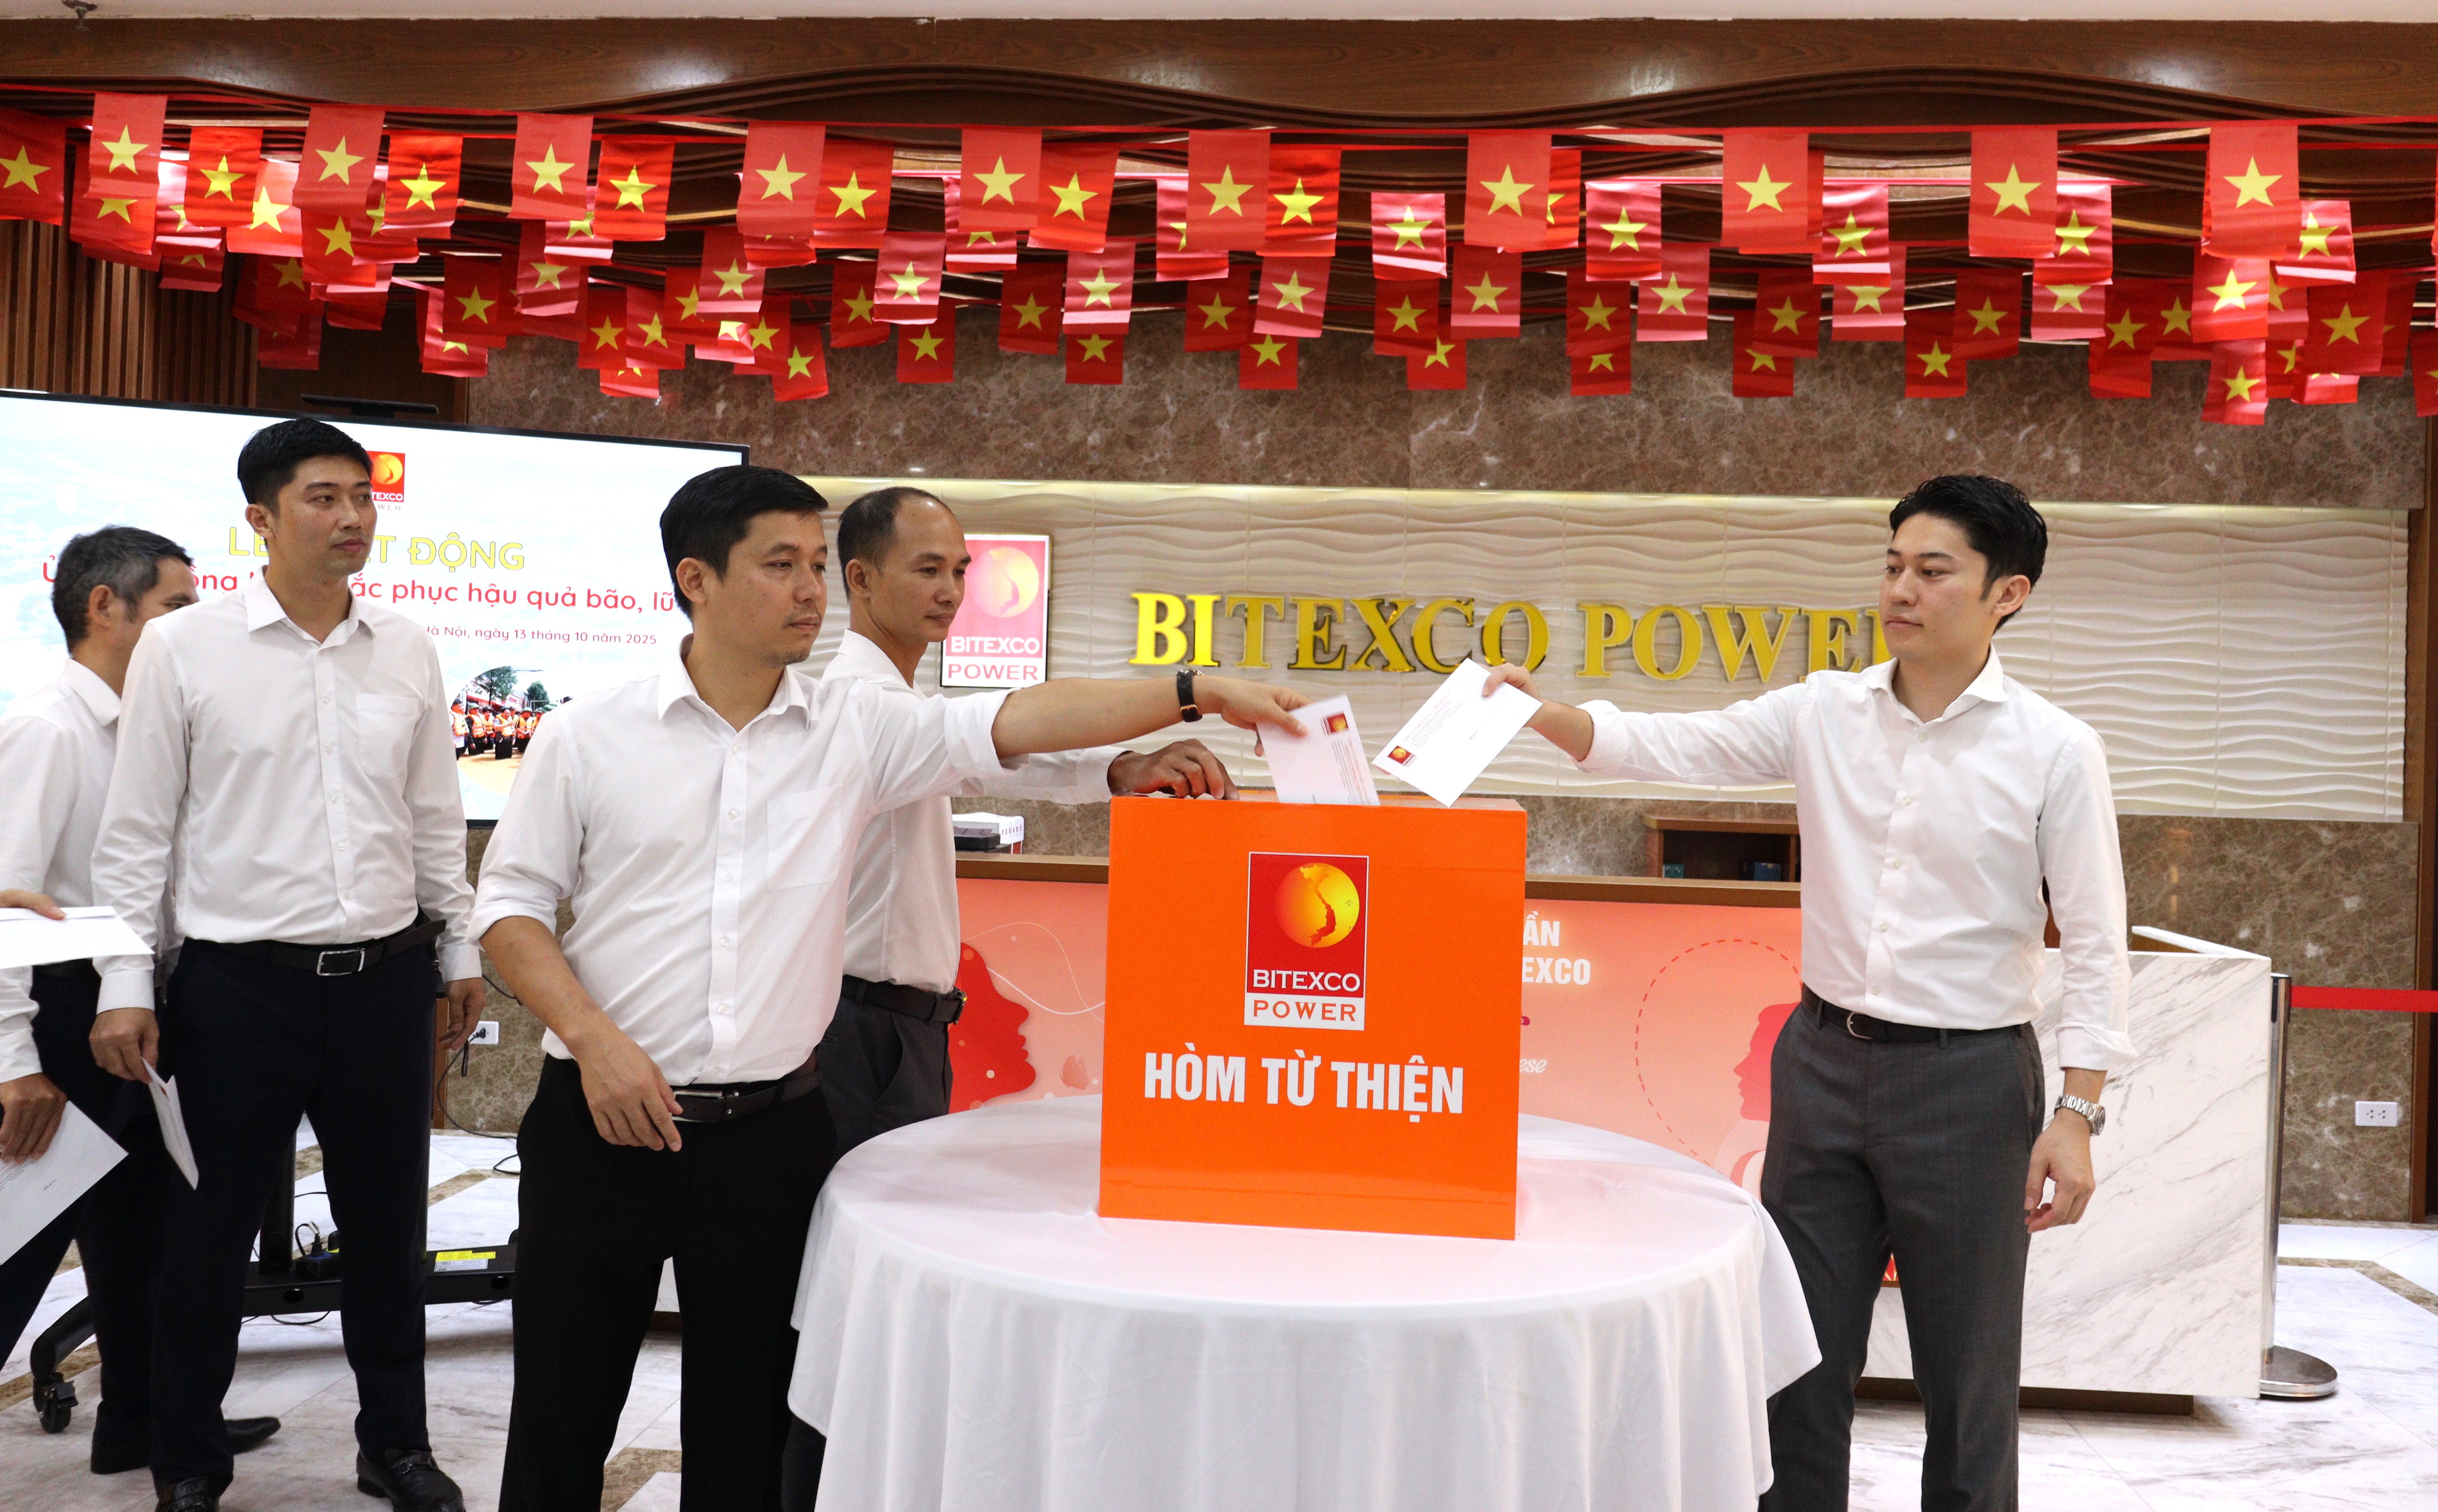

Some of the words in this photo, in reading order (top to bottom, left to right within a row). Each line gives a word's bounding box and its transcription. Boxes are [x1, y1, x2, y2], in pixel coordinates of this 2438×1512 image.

[372, 492, 403, 501] TEXCO
[408, 532, 524, 573] ĐỘNG
[351, 573, 382, 598] ắc
[393, 580, 458, 605] phục
[469, 583, 516, 607] hậu
[527, 587, 576, 610] quả
[587, 588, 643, 613] bão,
[653, 592, 674, 612] lũ
[445, 626, 470, 638] Nội,
[475, 628, 509, 641] ngày
[514, 629, 526, 639] 13
[531, 630, 570, 643] tháng
[575, 632, 588, 641] 10
[592, 633, 621, 643] năm
[626, 634, 656, 644] 2025
[950, 636, 1040, 654] BITEXCO
[1128, 592, 1549, 675] BITEXCO
[948, 664, 1039, 680] POWER
[1523, 911, 1560, 947] ẦN
[1253, 969, 1361, 992] BITEXCO
[1522, 957, 1591, 985] EXCO
[1253, 1000, 1356, 1021] POWER
[1144, 1042, 1246, 1103] HÒM
[1261, 1049, 1321, 1106] TỪ
[1331, 1055, 1464, 1123] THIỆN
